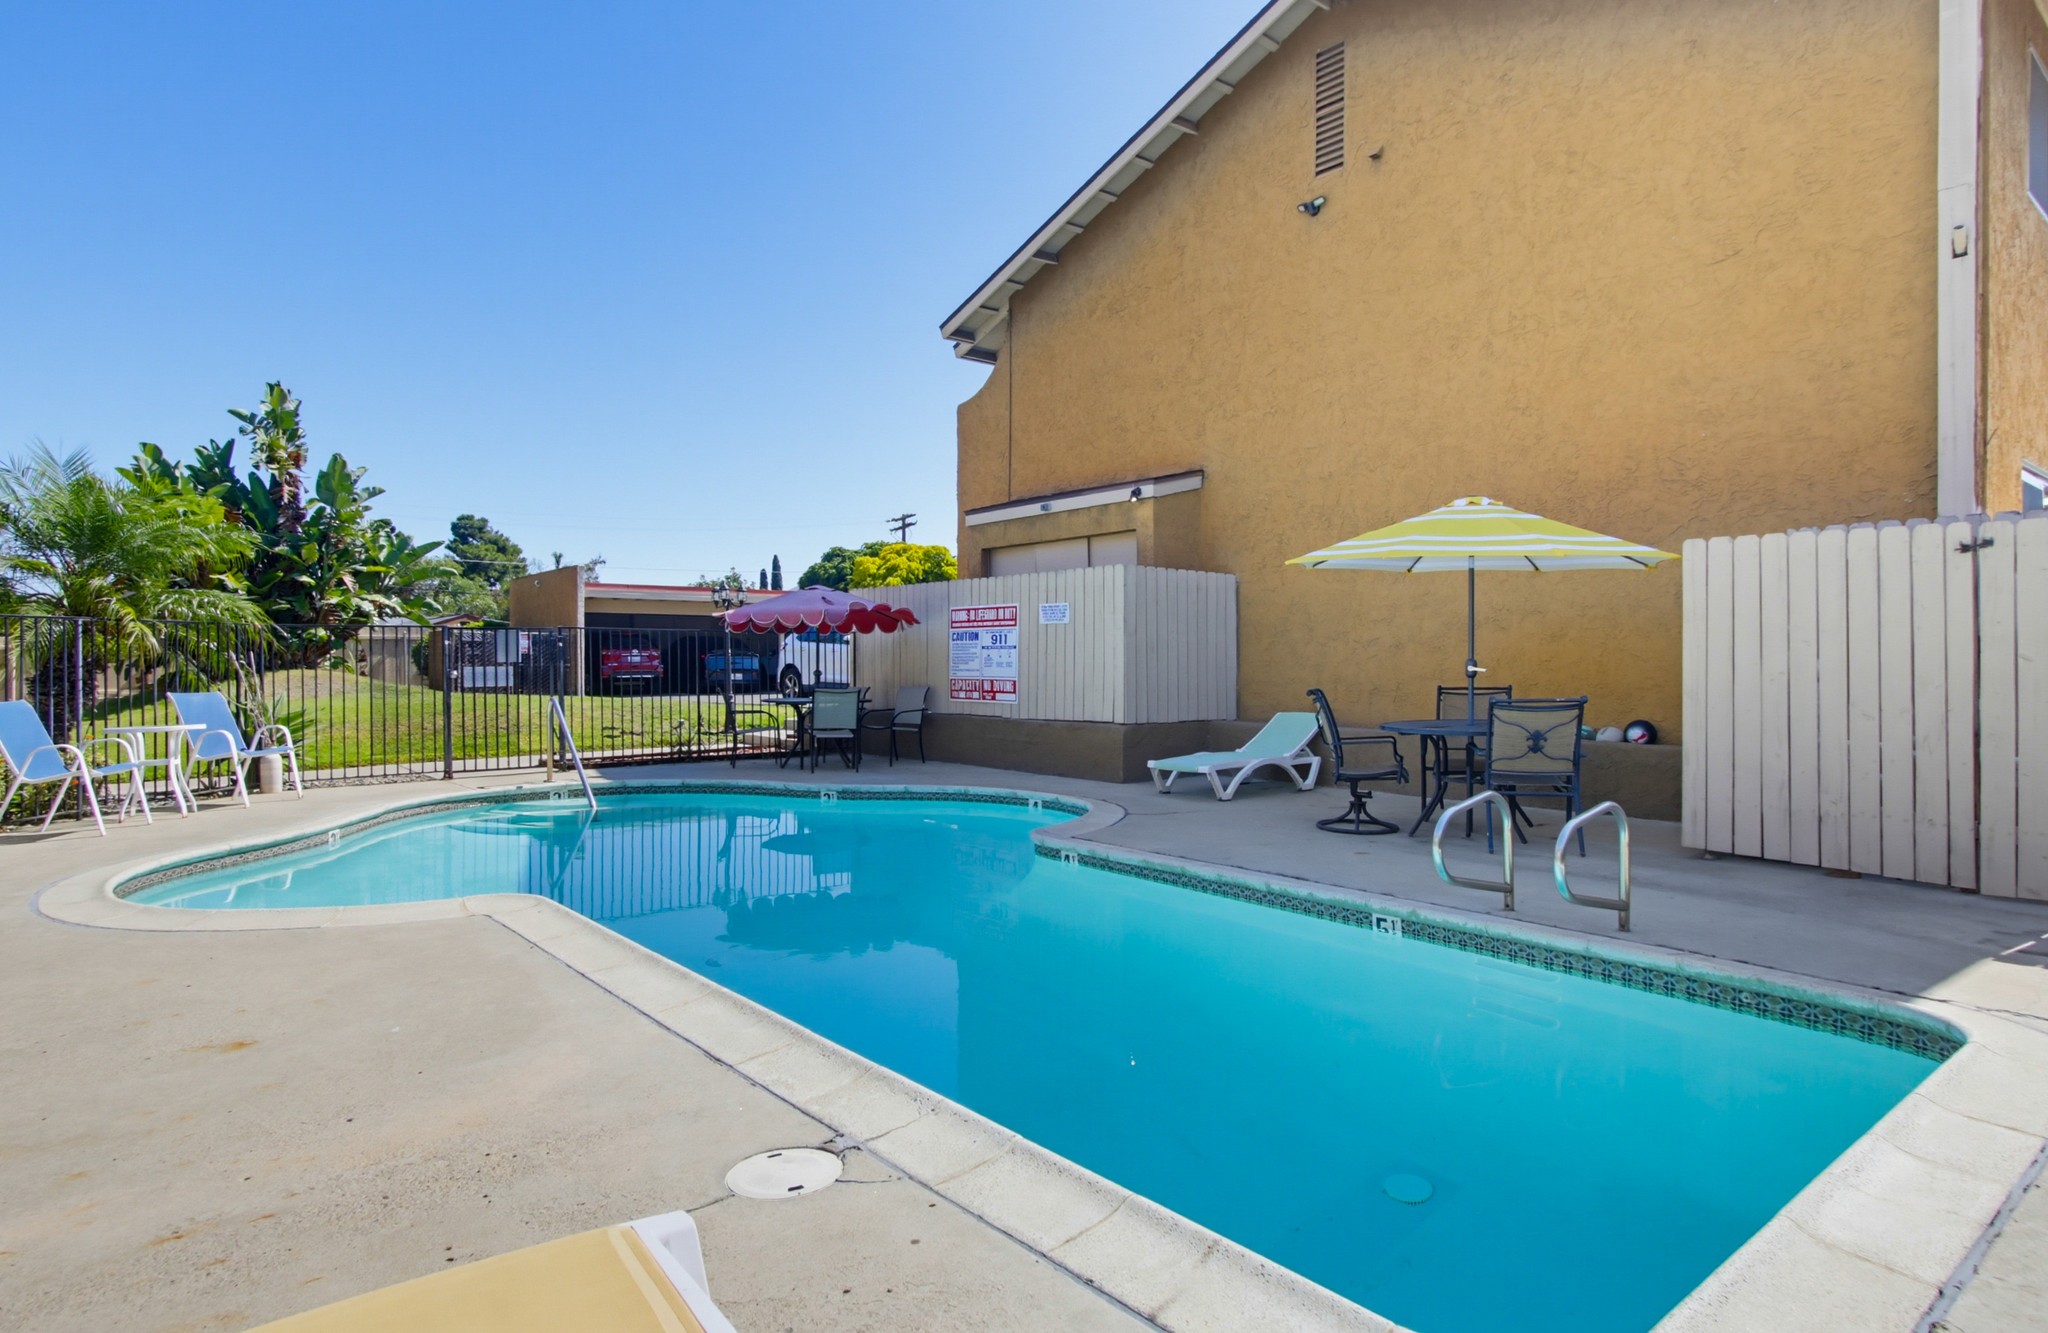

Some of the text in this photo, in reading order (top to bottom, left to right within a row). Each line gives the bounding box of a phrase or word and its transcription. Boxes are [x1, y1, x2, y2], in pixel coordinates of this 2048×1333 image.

[952, 631, 979, 642] CAUTION
[991, 634, 1008, 645] 911
[951, 679, 979, 691] CAPACITY
[993, 680, 1014, 692] DIVING
